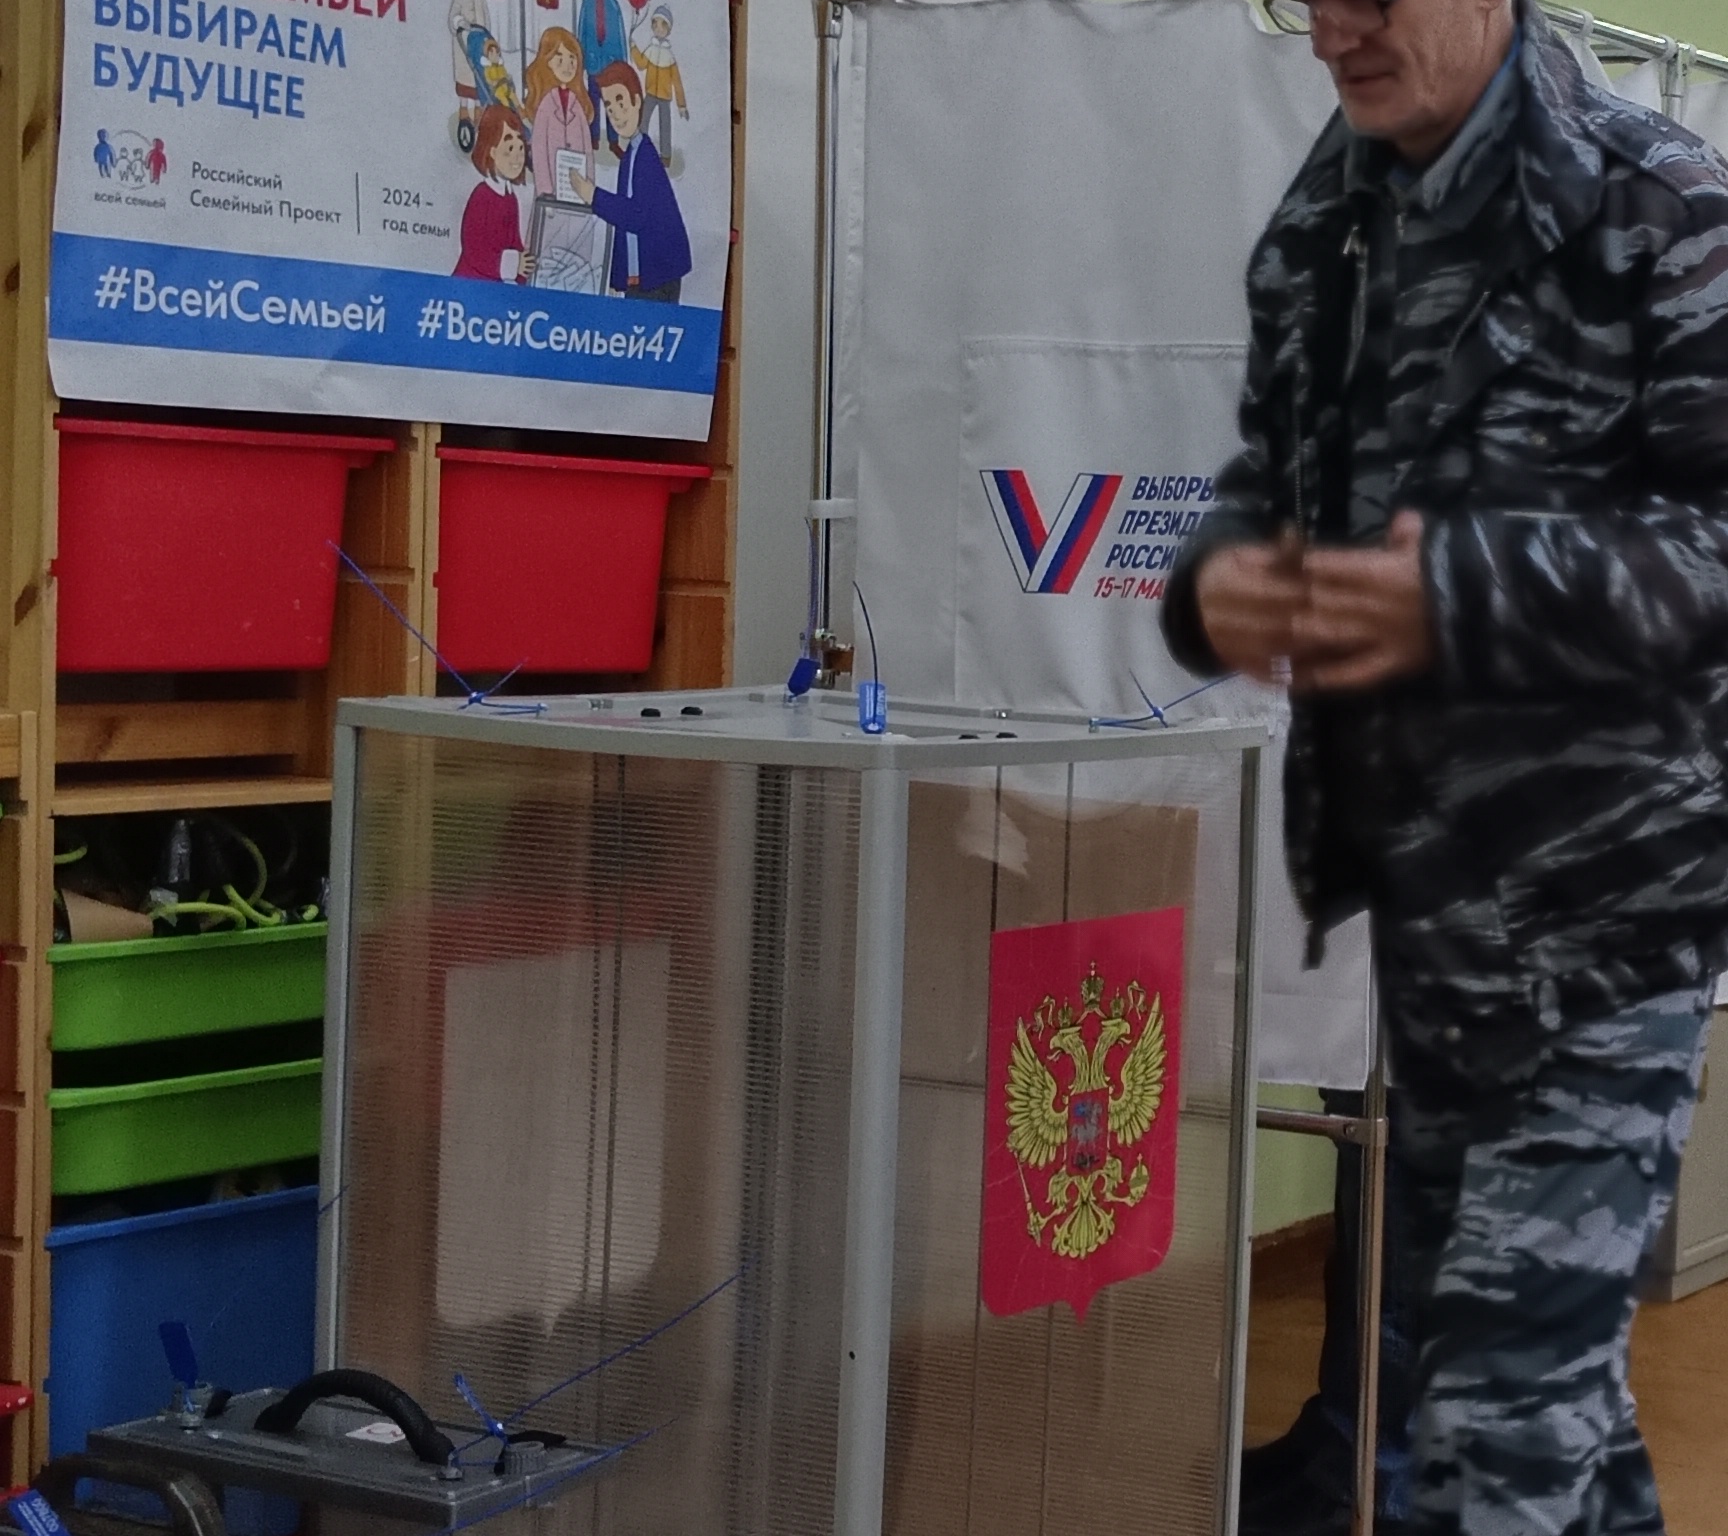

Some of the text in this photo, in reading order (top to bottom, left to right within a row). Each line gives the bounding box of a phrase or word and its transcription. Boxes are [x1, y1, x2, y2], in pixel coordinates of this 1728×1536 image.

[93, 42, 307, 120] БУДУЩЕЕ
[191, 161, 284, 191] Российский
[189, 188, 343, 224] Семейный Проект
[382, 187, 422, 209] 2024
[383, 217, 452, 240] год семьи
[94, 265, 386, 334] #ВсейСемьей
[417, 298, 685, 363] #ВсейСемьей47
[1104, 543, 1182, 571] РОССИ
[1093, 576, 1136, 599] 15-17
